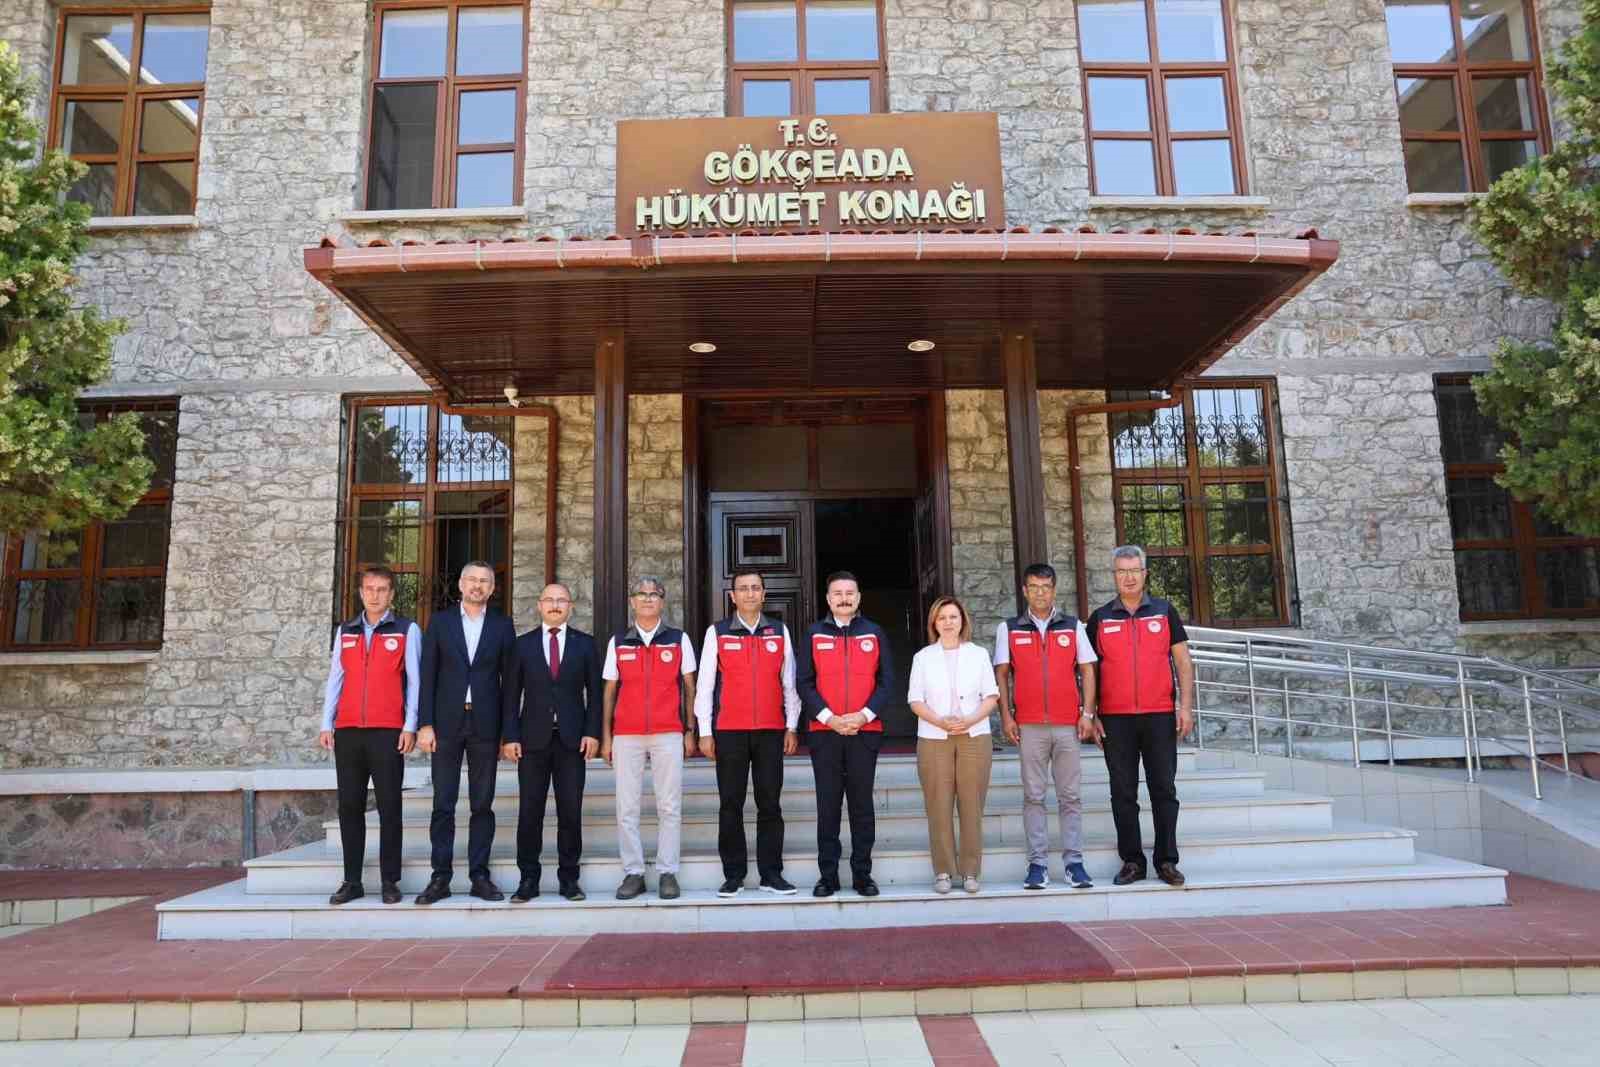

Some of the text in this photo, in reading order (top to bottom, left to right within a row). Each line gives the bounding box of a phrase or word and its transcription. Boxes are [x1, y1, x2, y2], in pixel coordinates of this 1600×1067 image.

[704, 144, 913, 188] GÖKÇEADA
[635, 182, 985, 229] HÜKÜMET KONAĞI
